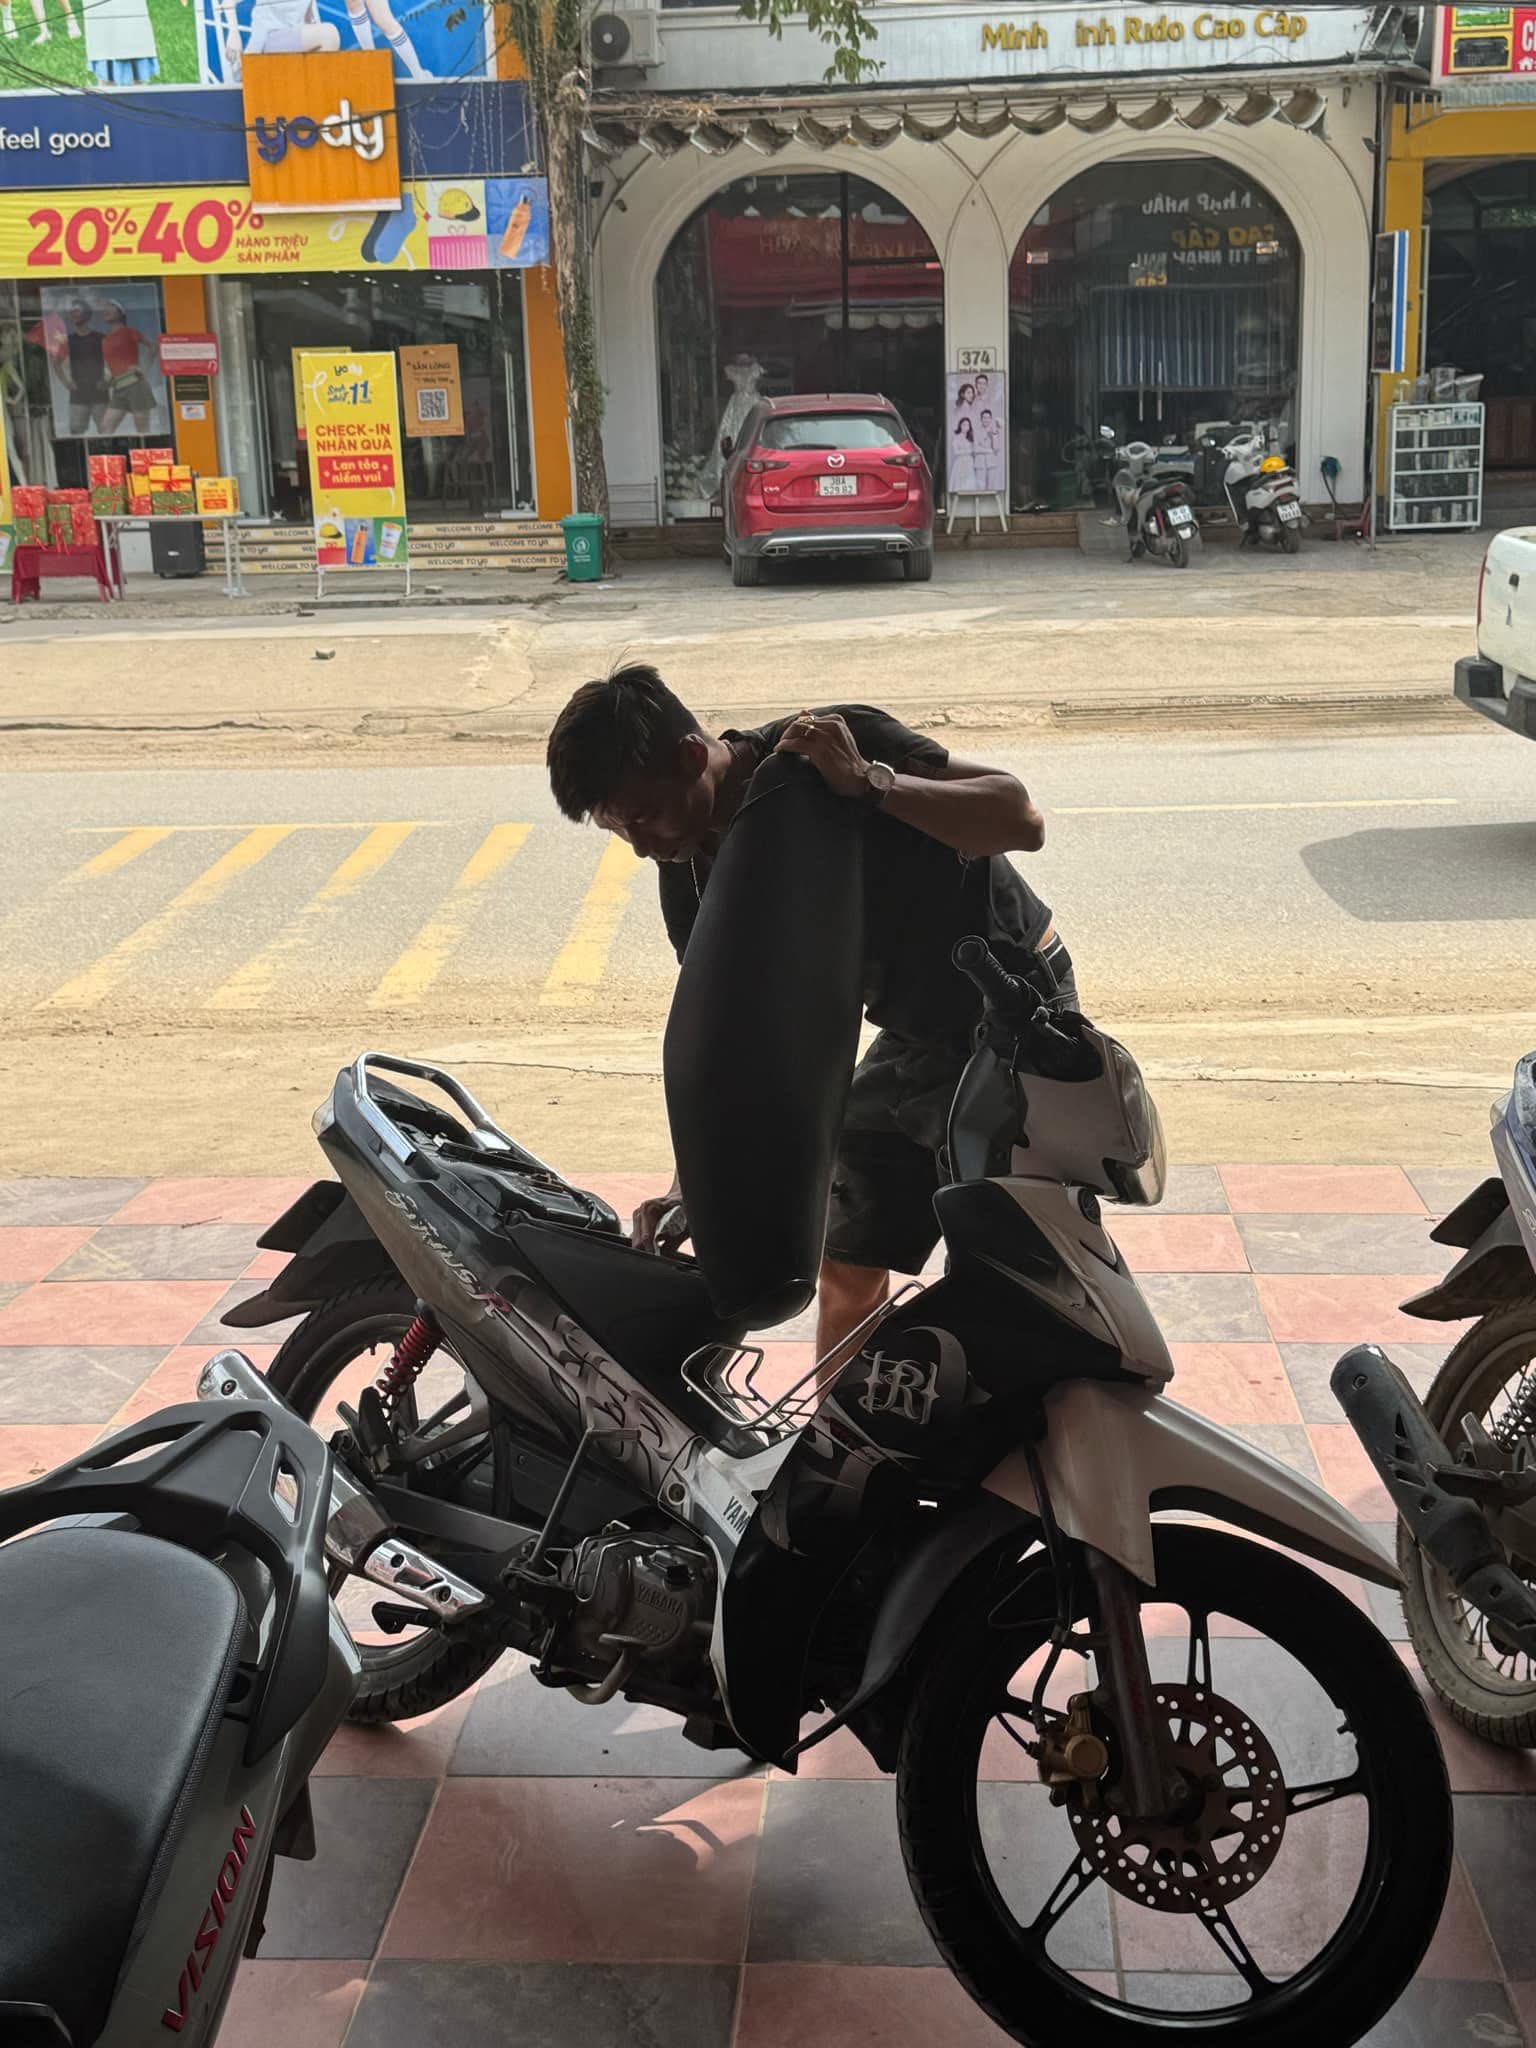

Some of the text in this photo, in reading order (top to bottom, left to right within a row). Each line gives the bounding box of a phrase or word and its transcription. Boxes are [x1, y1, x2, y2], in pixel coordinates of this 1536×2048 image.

[981, 21, 1048, 51] Minh
[1193, 11, 1245, 40] Cao
[0, 123, 111, 156] feel good
[255, 98, 384, 164] yody
[961, 350, 991, 366] 374
[315, 423, 391, 437] CHECK-IN
[361, 436, 393, 451] QUÀ
[332, 459, 356, 471] Lan
[363, 471, 382, 483] vui
[638, 1584, 684, 1617] YAMAHA
[161, 1804, 257, 2033] VISION
